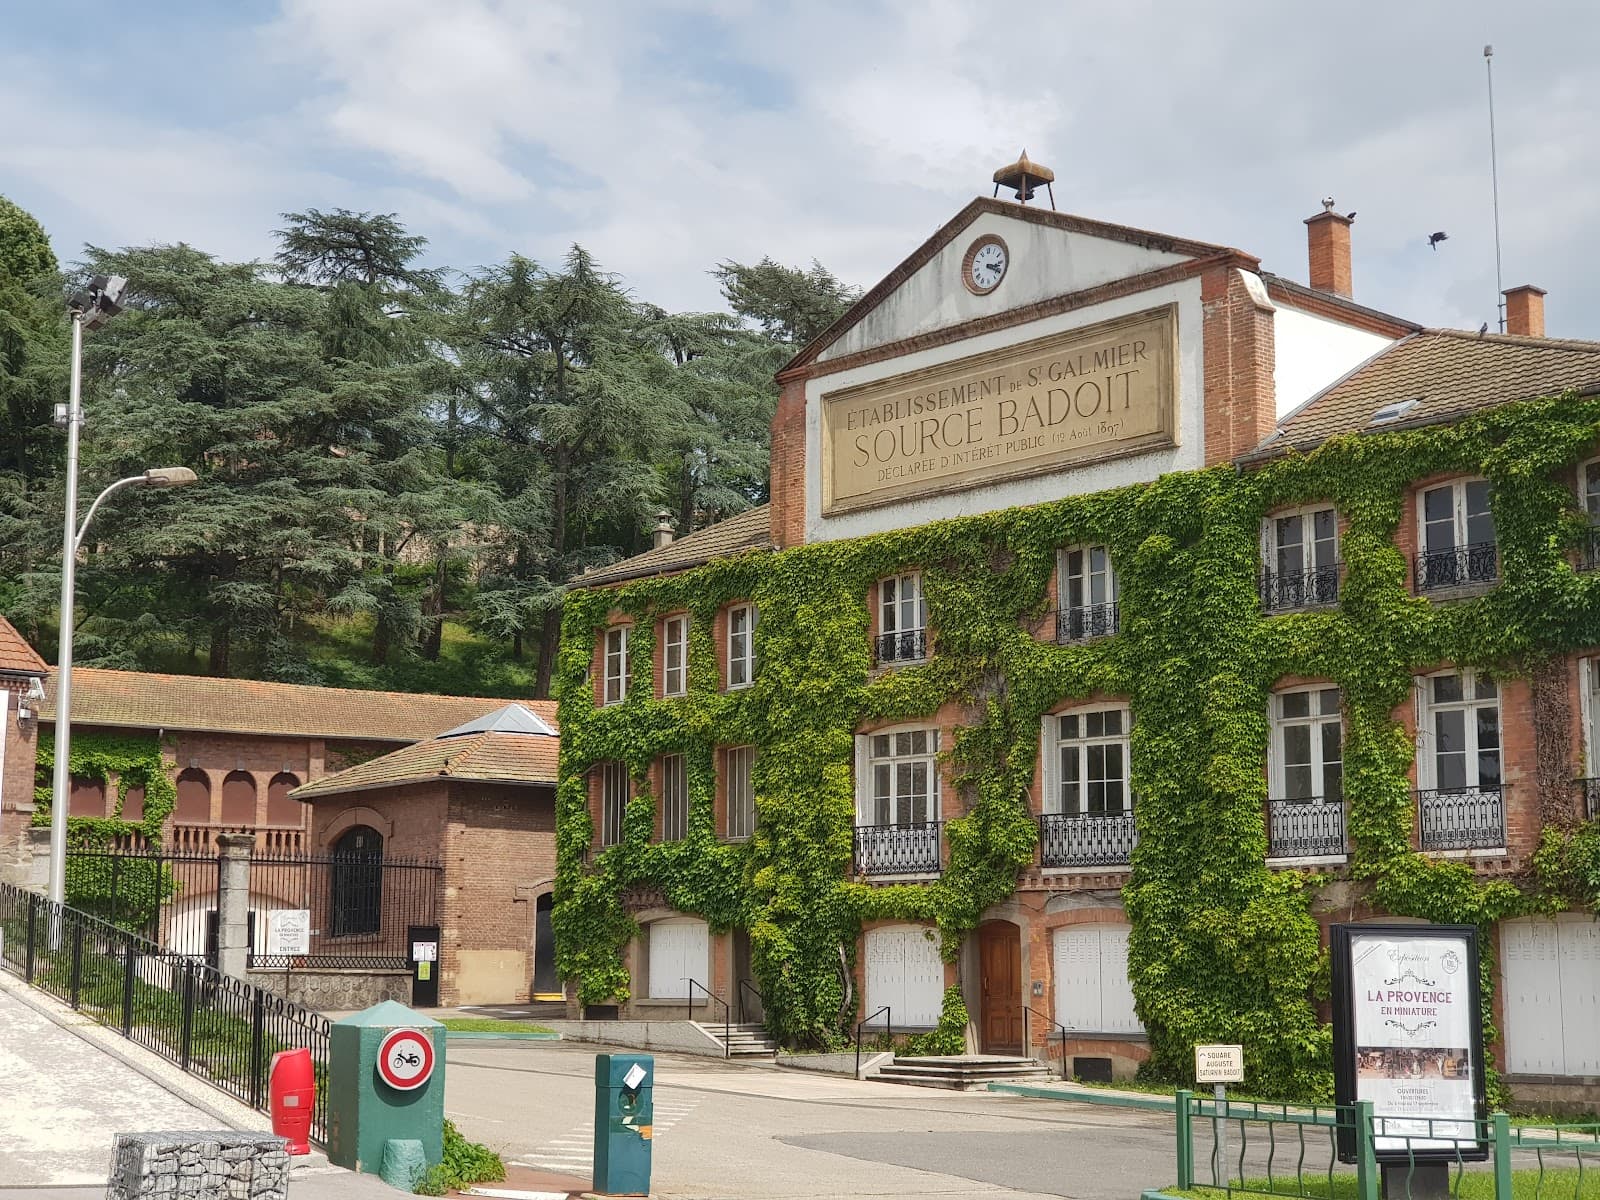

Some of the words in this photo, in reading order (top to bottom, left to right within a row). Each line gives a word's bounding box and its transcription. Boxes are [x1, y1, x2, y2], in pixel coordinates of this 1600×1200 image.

[847, 375, 1006, 431] ÉTABLISSEMENT
[1009, 380, 1023, 393] DE
[1048, 340, 1150, 382] GALMIER
[853, 406, 984, 468] SOURCE
[998, 369, 1140, 437] BADOIT
[1005, 434, 1046, 455] PUBLIC
[1367, 990, 1384, 1002] LA
[1387, 990, 1453, 1003] PROVENCE
[1381, 1006, 1393, 1015] EN
[1394, 1007, 1438, 1016] MINIATURE
[1206, 1060, 1233, 1068] AUGUSTE
[1223, 1068, 1241, 1076] BADOIT
